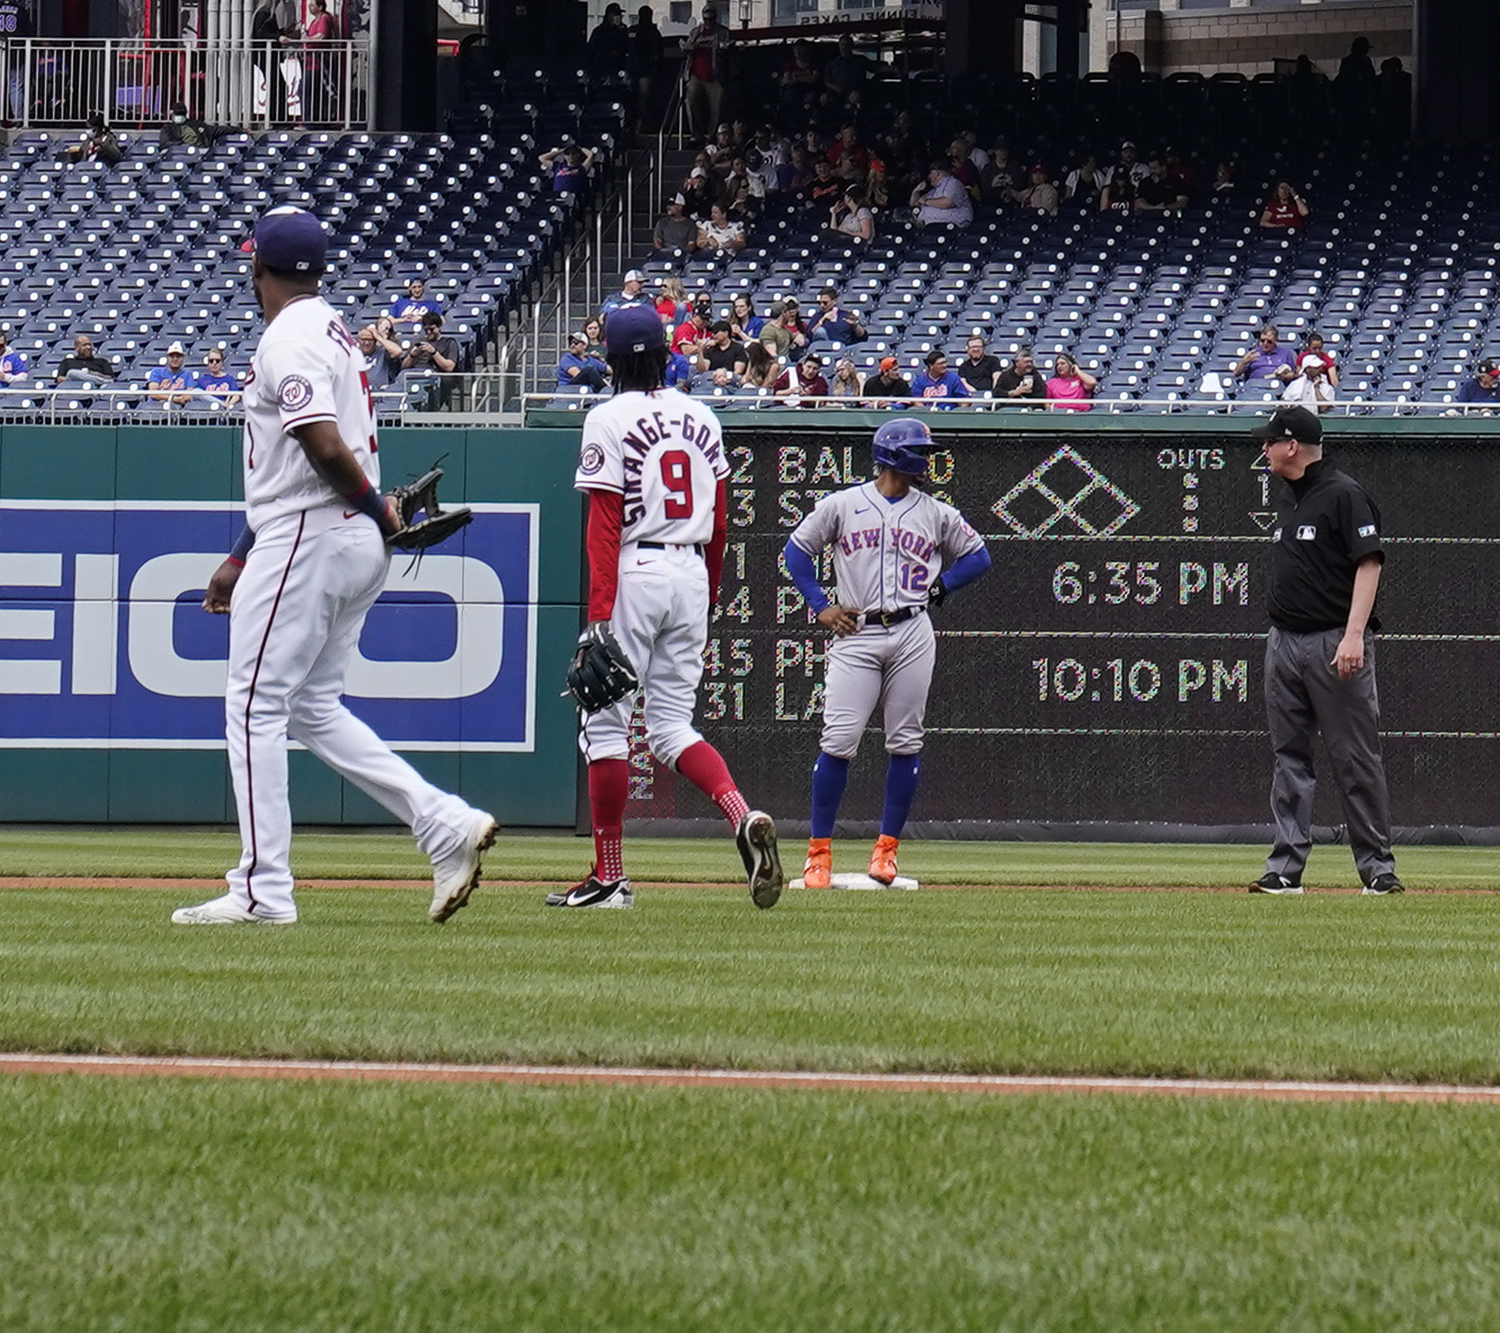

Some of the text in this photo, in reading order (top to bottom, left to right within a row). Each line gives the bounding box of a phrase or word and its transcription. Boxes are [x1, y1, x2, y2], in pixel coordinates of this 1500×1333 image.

[778, 447, 866, 484] BAL
[1156, 448, 1226, 470] OUTS
[658, 449, 694, 521] 9
[840, 526, 934, 564] NEW YORK
[900, 562, 929, 592] 12
[1052, 560, 1249, 606] 6:35 PM
[1031, 657, 1249, 704] 10:10 PM
[703, 682, 745, 720] 31
